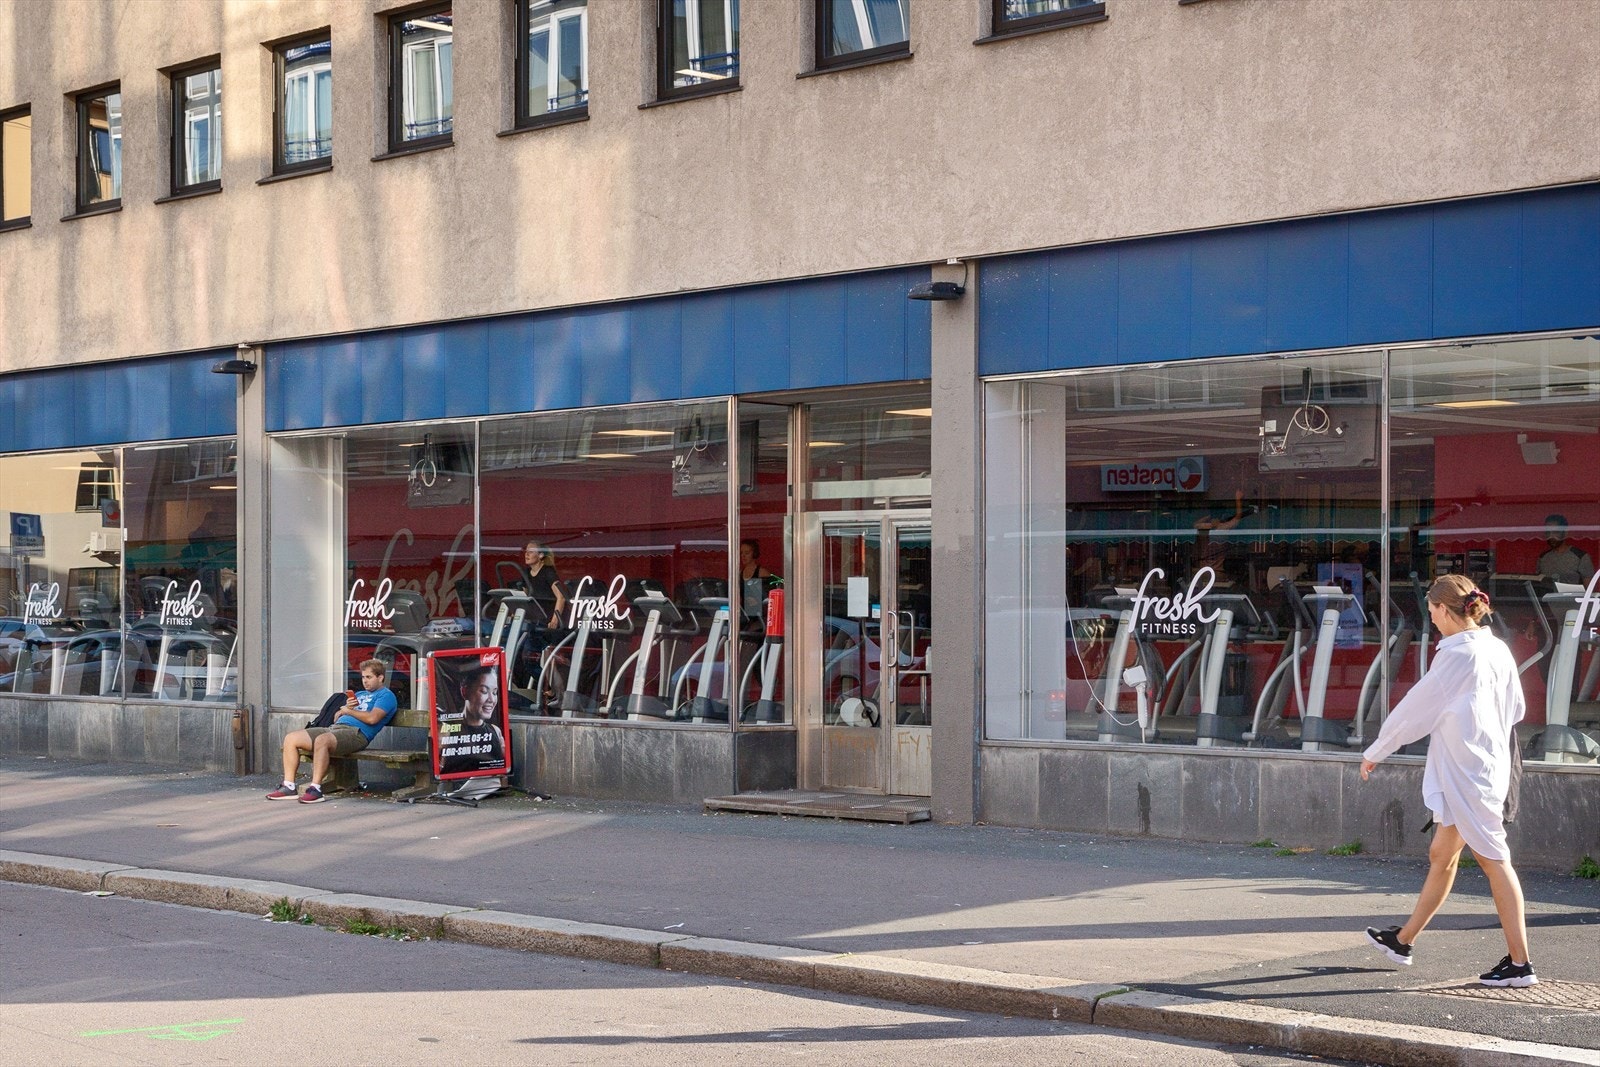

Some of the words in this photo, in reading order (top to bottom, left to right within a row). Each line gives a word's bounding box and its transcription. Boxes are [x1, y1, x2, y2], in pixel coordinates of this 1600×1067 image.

[24, 582, 62, 625] fresh
[160, 579, 204, 625] fresh
[344, 578, 396, 628] fresh
[568, 574, 630, 629] fresh
[1127, 566, 1221, 633] fresh
[29, 618, 52, 626] FITNESS
[166, 617, 193, 626] FITNESS
[351, 619, 382, 628] FITNESS
[577, 620, 614, 629] FITNESS
[1141, 623, 1196, 634] FITNESS
[472, 733, 492, 742] 05-21
